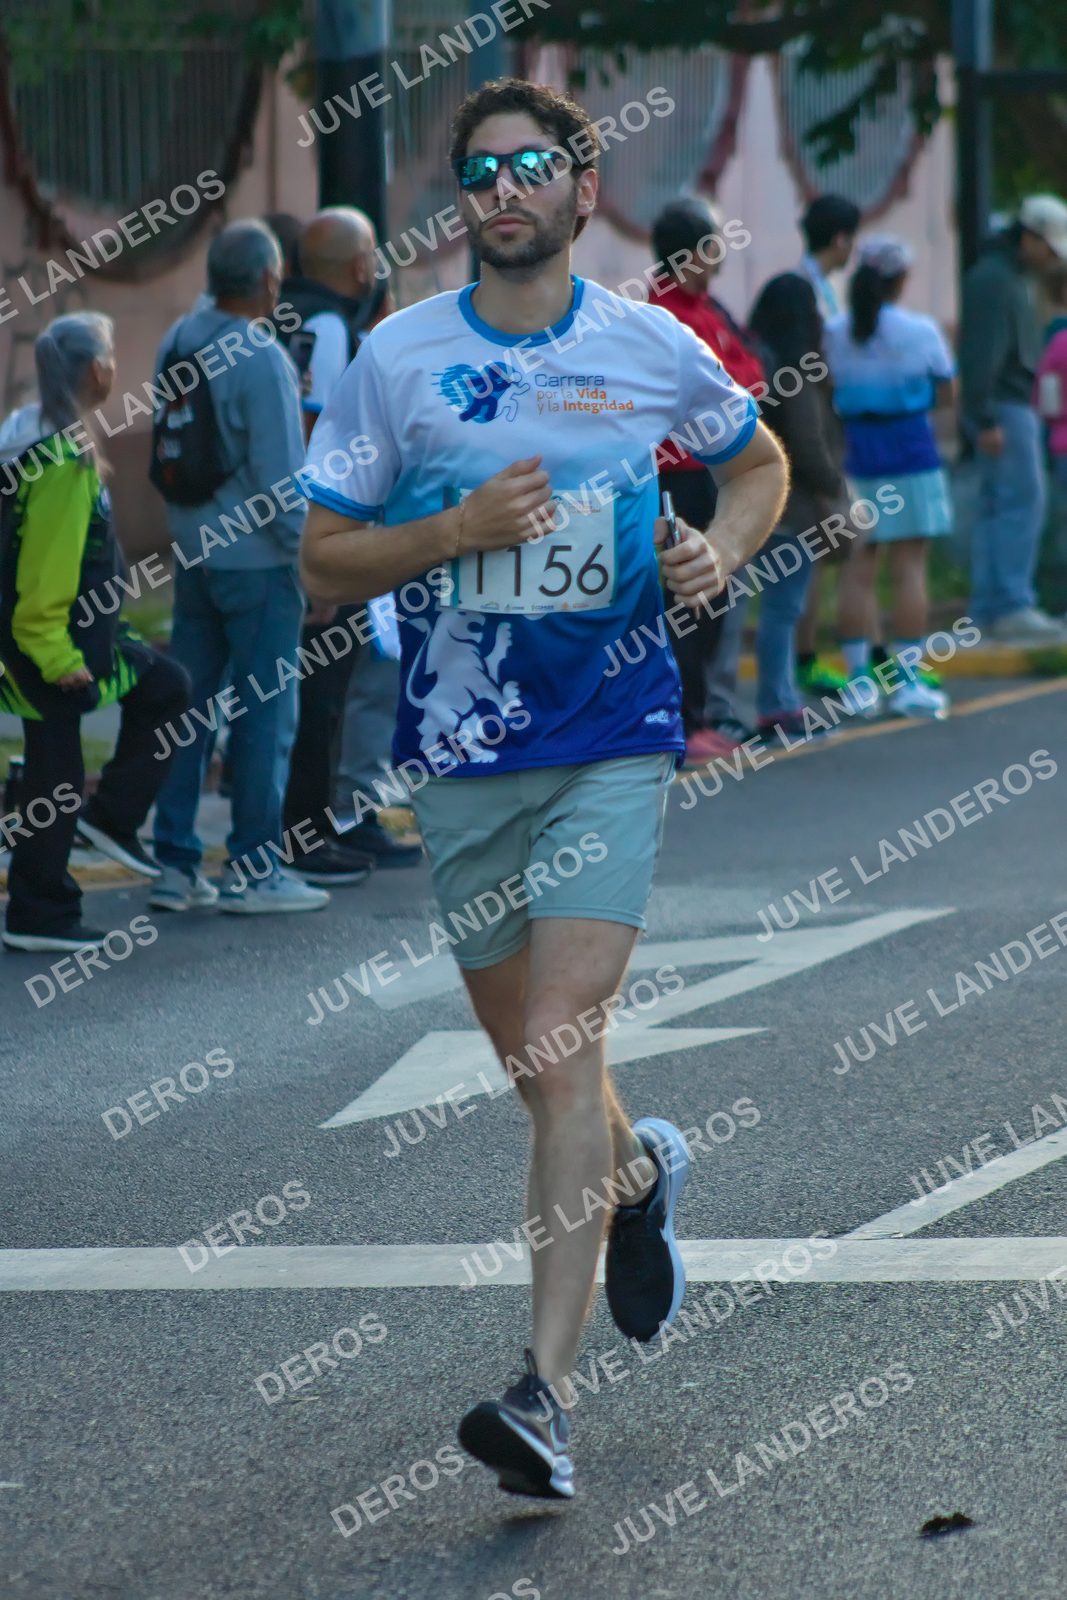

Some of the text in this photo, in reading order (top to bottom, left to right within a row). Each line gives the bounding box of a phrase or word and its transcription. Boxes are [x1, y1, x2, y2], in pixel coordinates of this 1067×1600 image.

[535, 374, 605, 387] Carrera
[536, 389, 557, 401] por
[576, 388, 607, 399] Vida
[563, 400, 634, 414] Integridad
[476, 543, 609, 597] 1156
